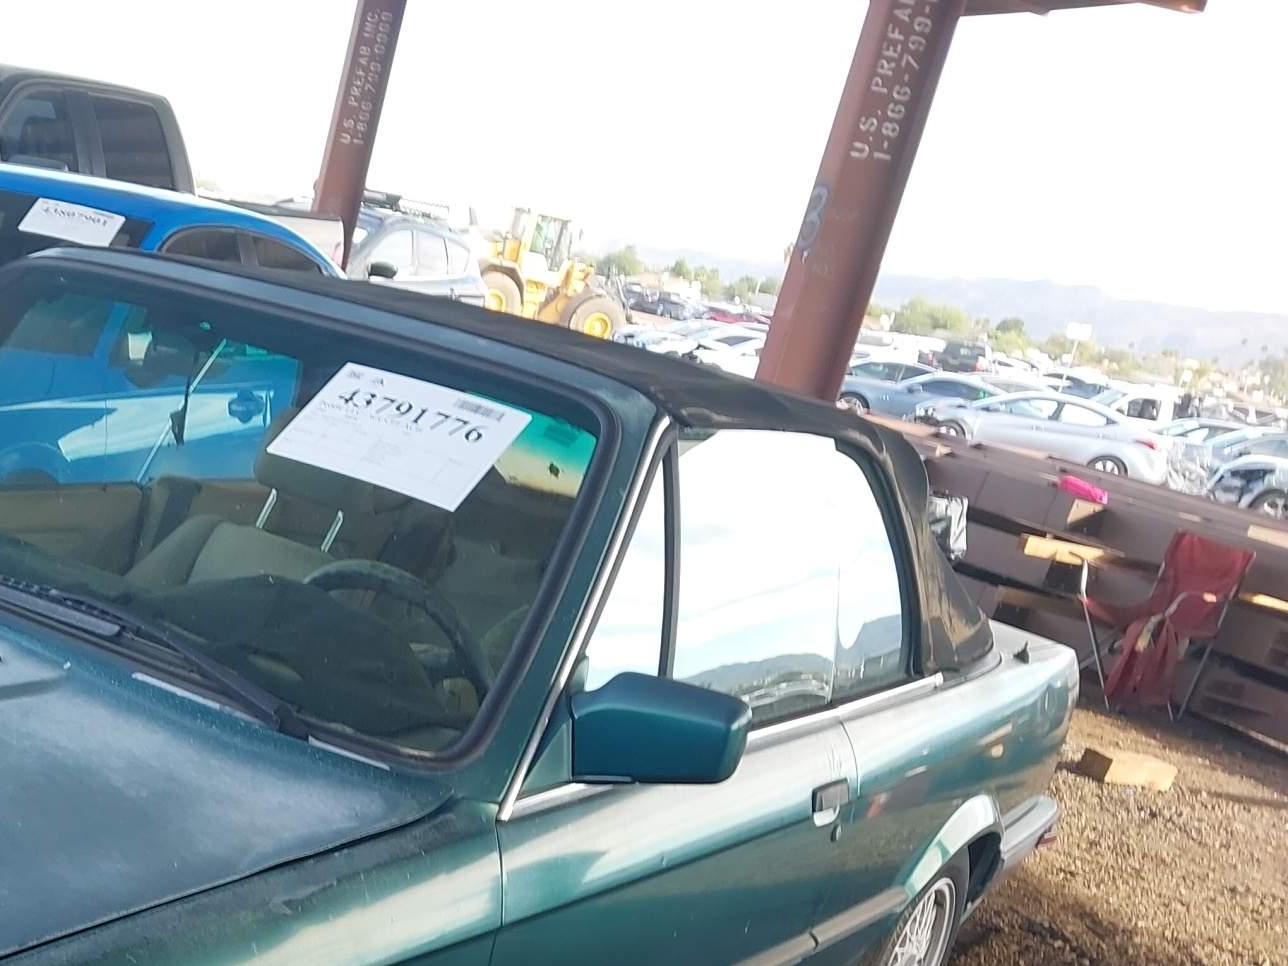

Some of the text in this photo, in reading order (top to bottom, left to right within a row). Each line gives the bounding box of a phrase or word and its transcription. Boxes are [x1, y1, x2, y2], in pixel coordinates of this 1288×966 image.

[340, 8, 381, 144] U.S. PREFAB INC.
[873, 0, 939, 161] 1-866-799-
[850, 108, 882, 160] U.S.
[339, 388, 485, 443] 43791776
